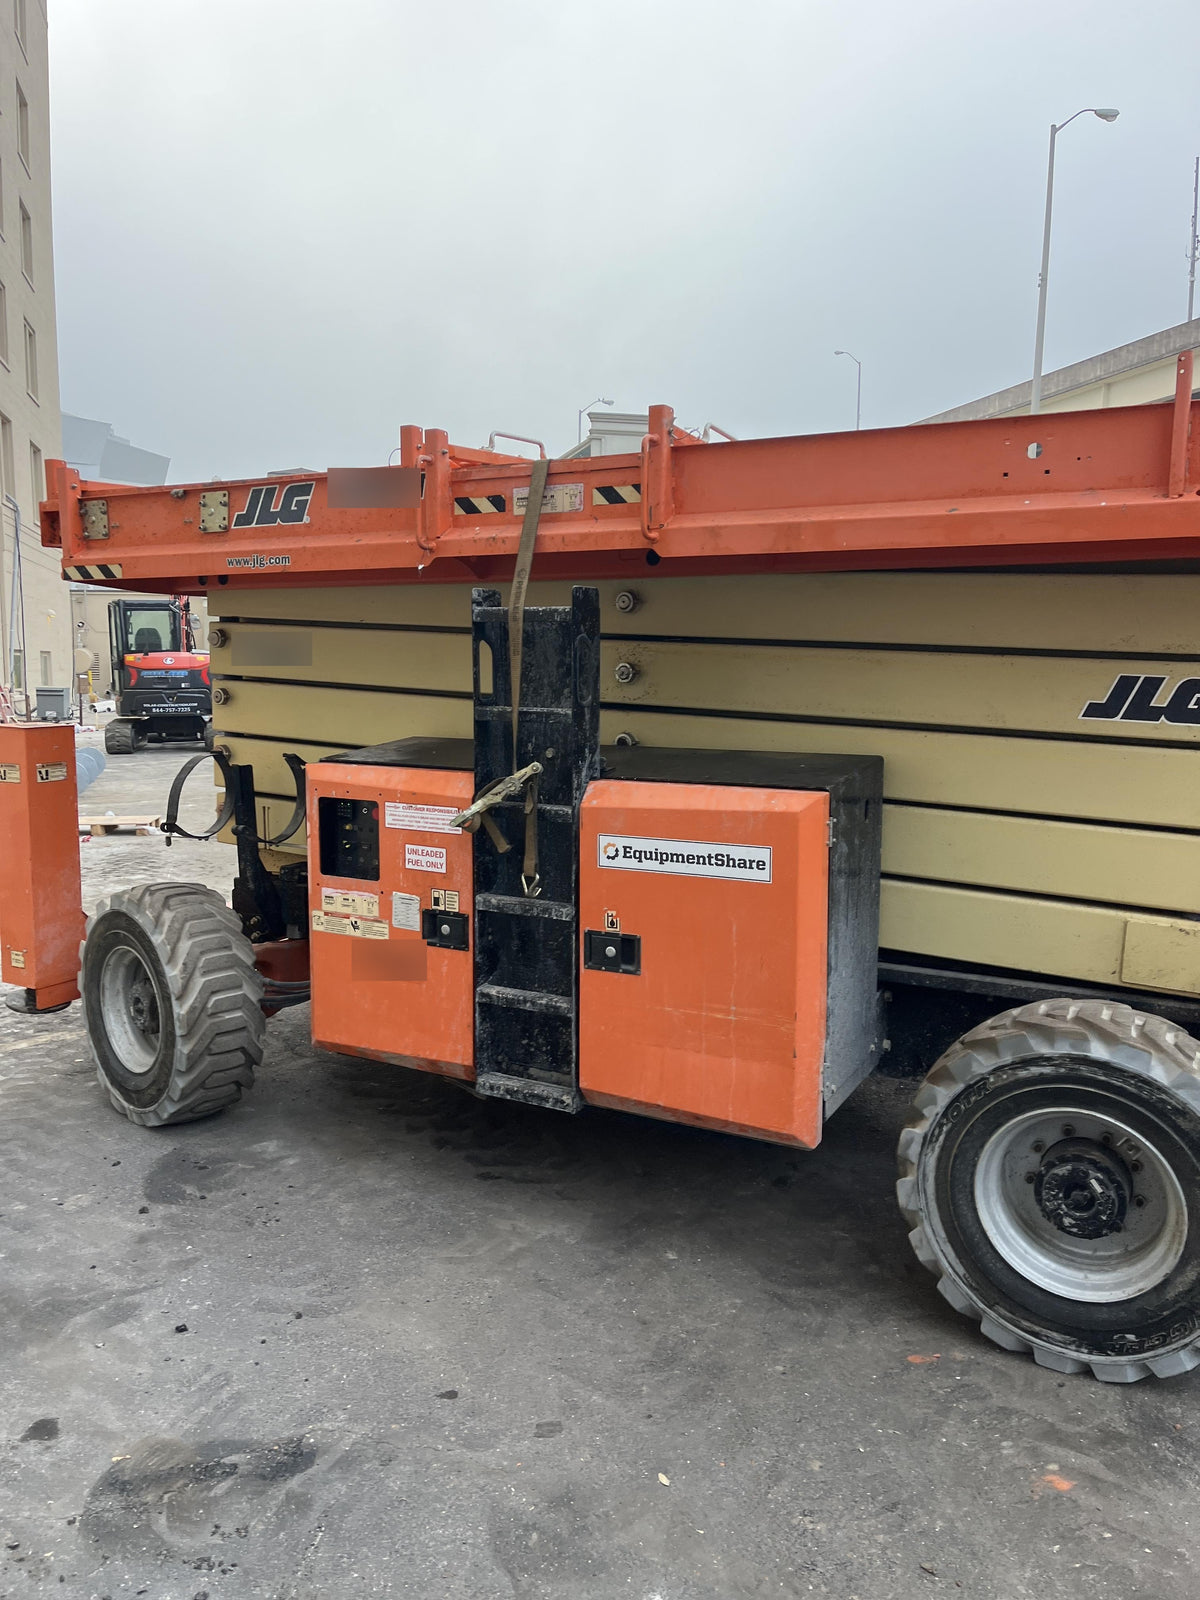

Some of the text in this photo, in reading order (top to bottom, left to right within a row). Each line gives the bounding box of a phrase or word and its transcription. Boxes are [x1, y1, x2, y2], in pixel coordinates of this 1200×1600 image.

[231, 481, 315, 529] JLG
[226, 554, 291, 569] www.jlg.com
[407, 847, 444, 859] UNLEADED
[622, 845, 767, 871] EquipmentShare
[407, 858, 444, 870] FUEL ONLY
